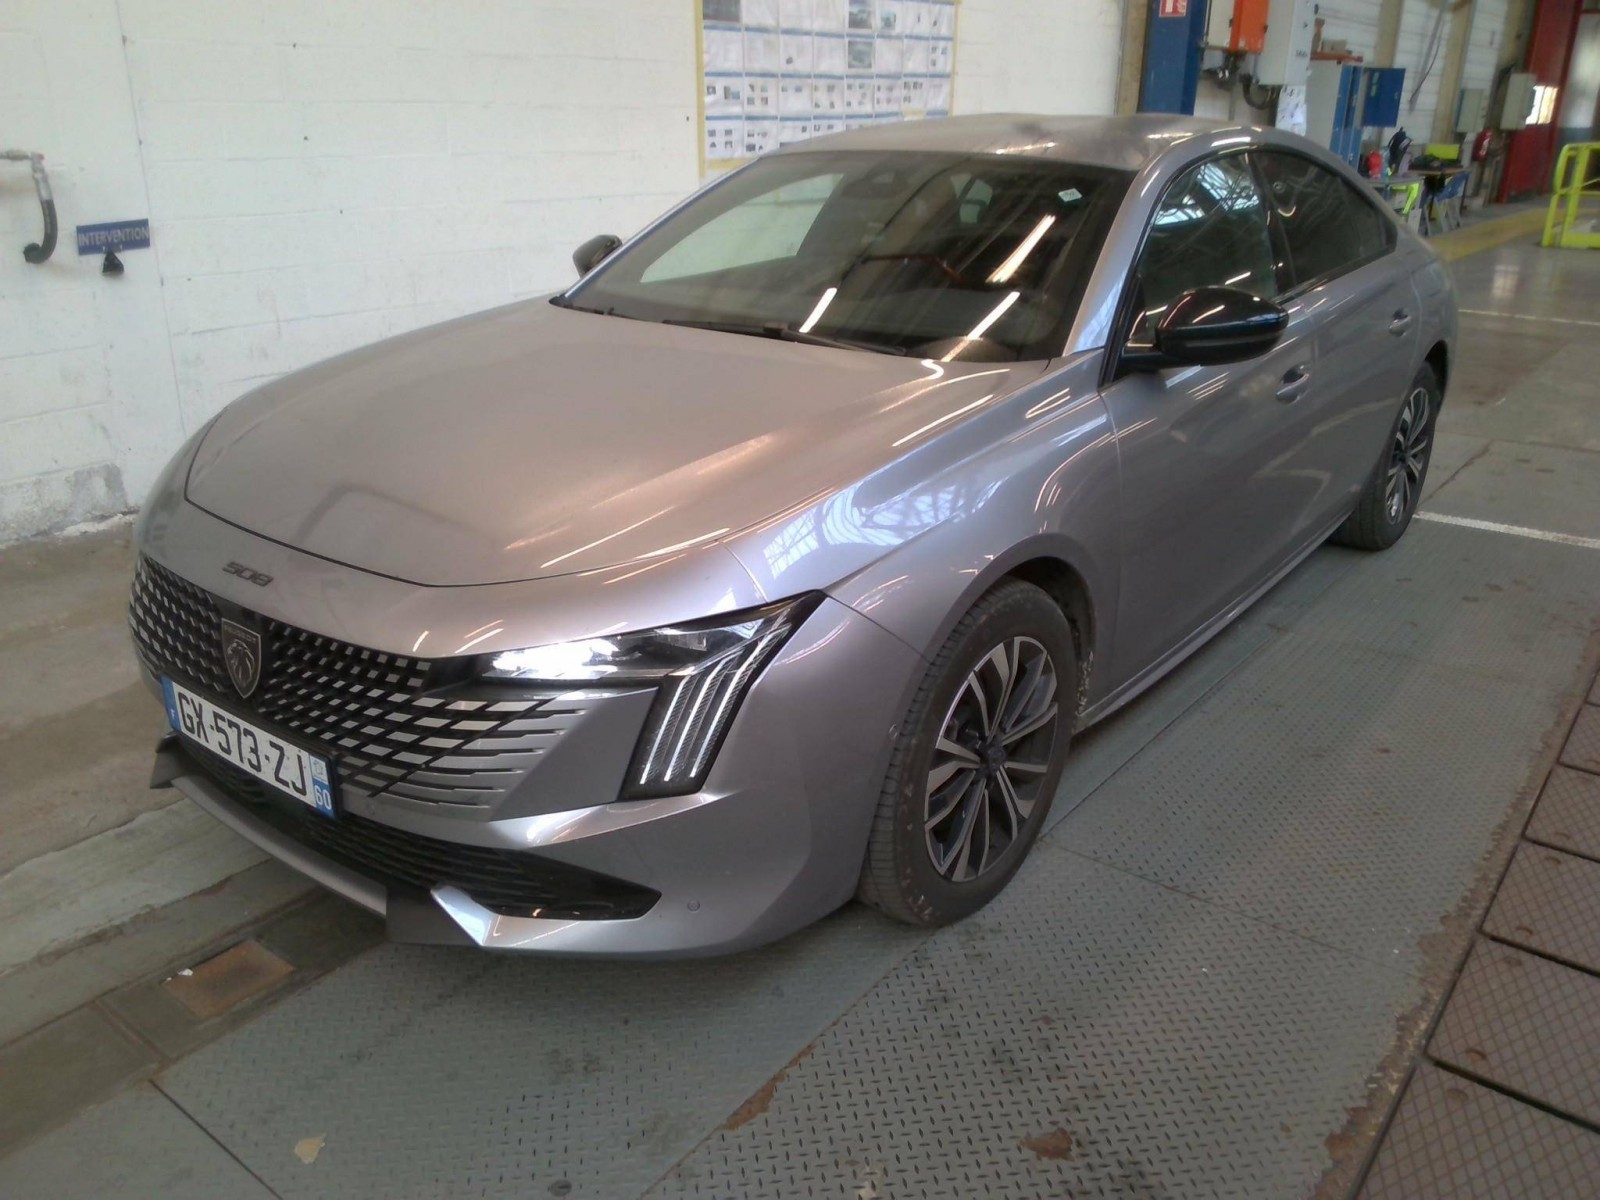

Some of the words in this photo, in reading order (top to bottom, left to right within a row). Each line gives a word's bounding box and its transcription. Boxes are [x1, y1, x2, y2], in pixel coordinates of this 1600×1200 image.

[78, 226, 150, 247] INTERVENTION
[221, 561, 274, 587] 508
[177, 692, 308, 797] GX-573-ZJ
[314, 784, 332, 810] 60
